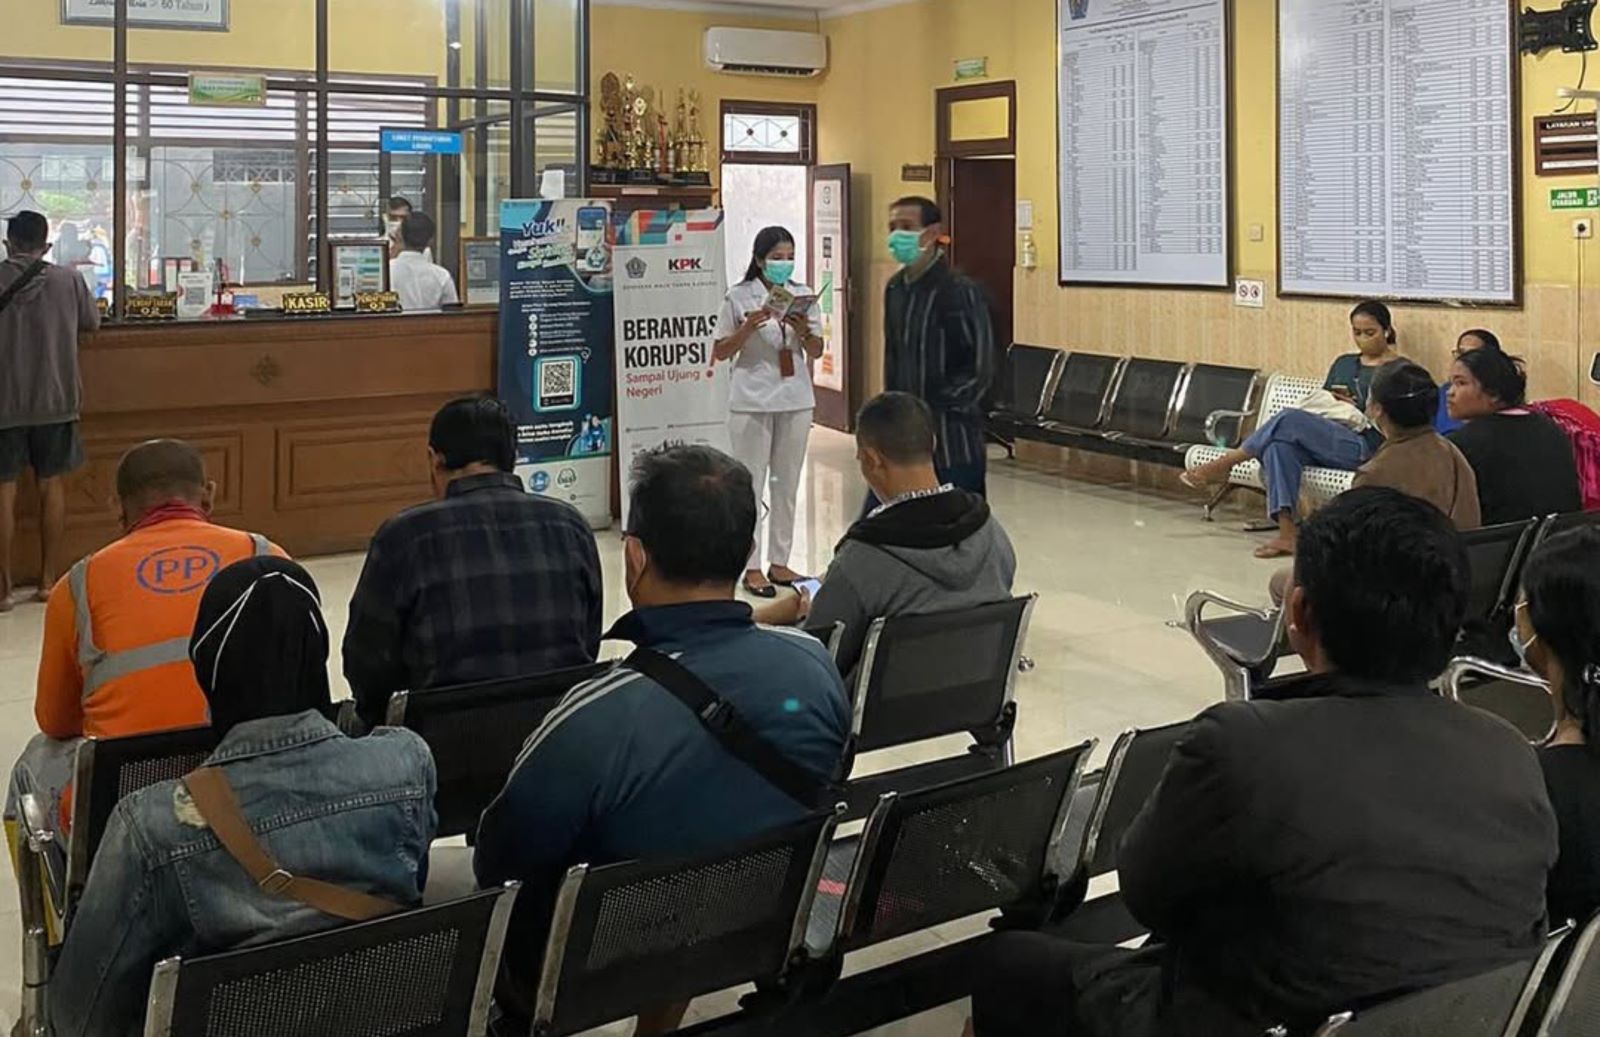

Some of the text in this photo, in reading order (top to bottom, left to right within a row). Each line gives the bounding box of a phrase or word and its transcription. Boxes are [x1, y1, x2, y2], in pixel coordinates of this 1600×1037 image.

[668, 258, 702, 271] KPK
[288, 296, 327, 309] KASIR
[623, 315, 718, 341] BERANTAS
[625, 342, 706, 368] KORUPSI
[626, 368, 701, 385] Sampai Ujung
[626, 385, 663, 399] Negeri
[156, 555, 208, 583] PP
